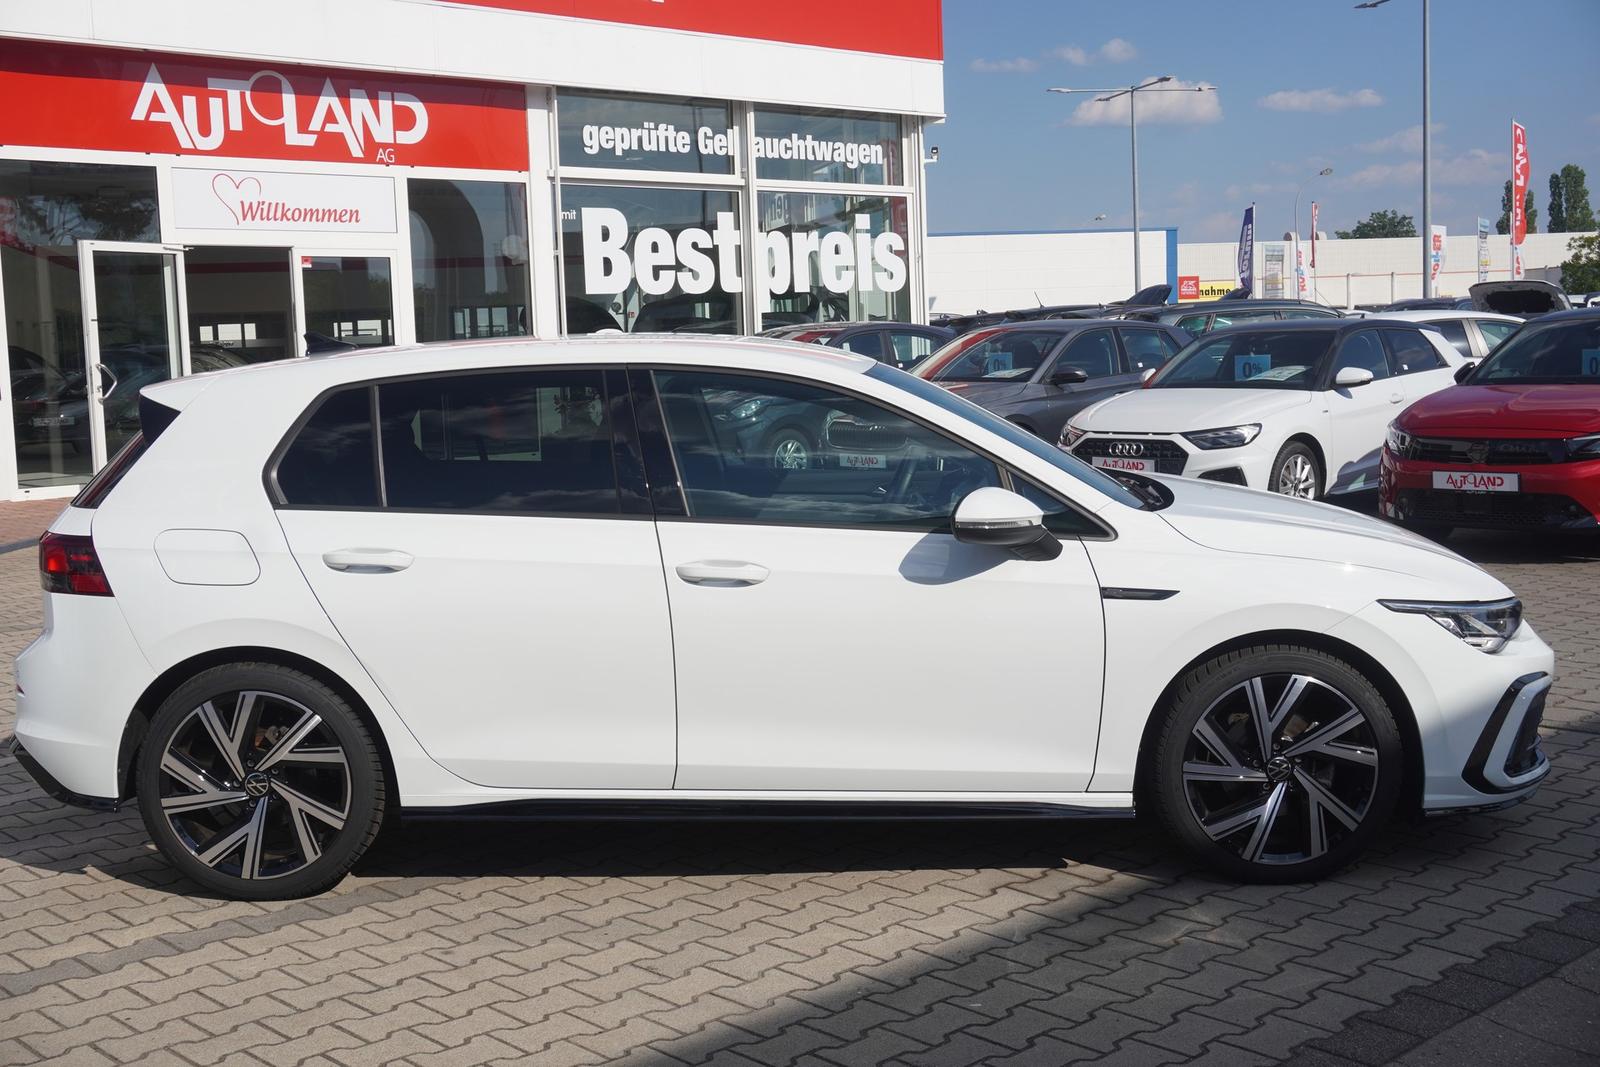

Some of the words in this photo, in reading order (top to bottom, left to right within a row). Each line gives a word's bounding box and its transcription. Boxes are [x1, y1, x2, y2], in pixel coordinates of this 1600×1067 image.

[130, 62, 429, 158] AUTOLAND
[376, 148, 396, 163] AG
[582, 121, 691, 156] geprüfte
[697, 126, 884, 169] Geauchtwagen
[239, 200, 361, 224] Willkommen
[1446, 473, 1504, 489] AUTOLAND
